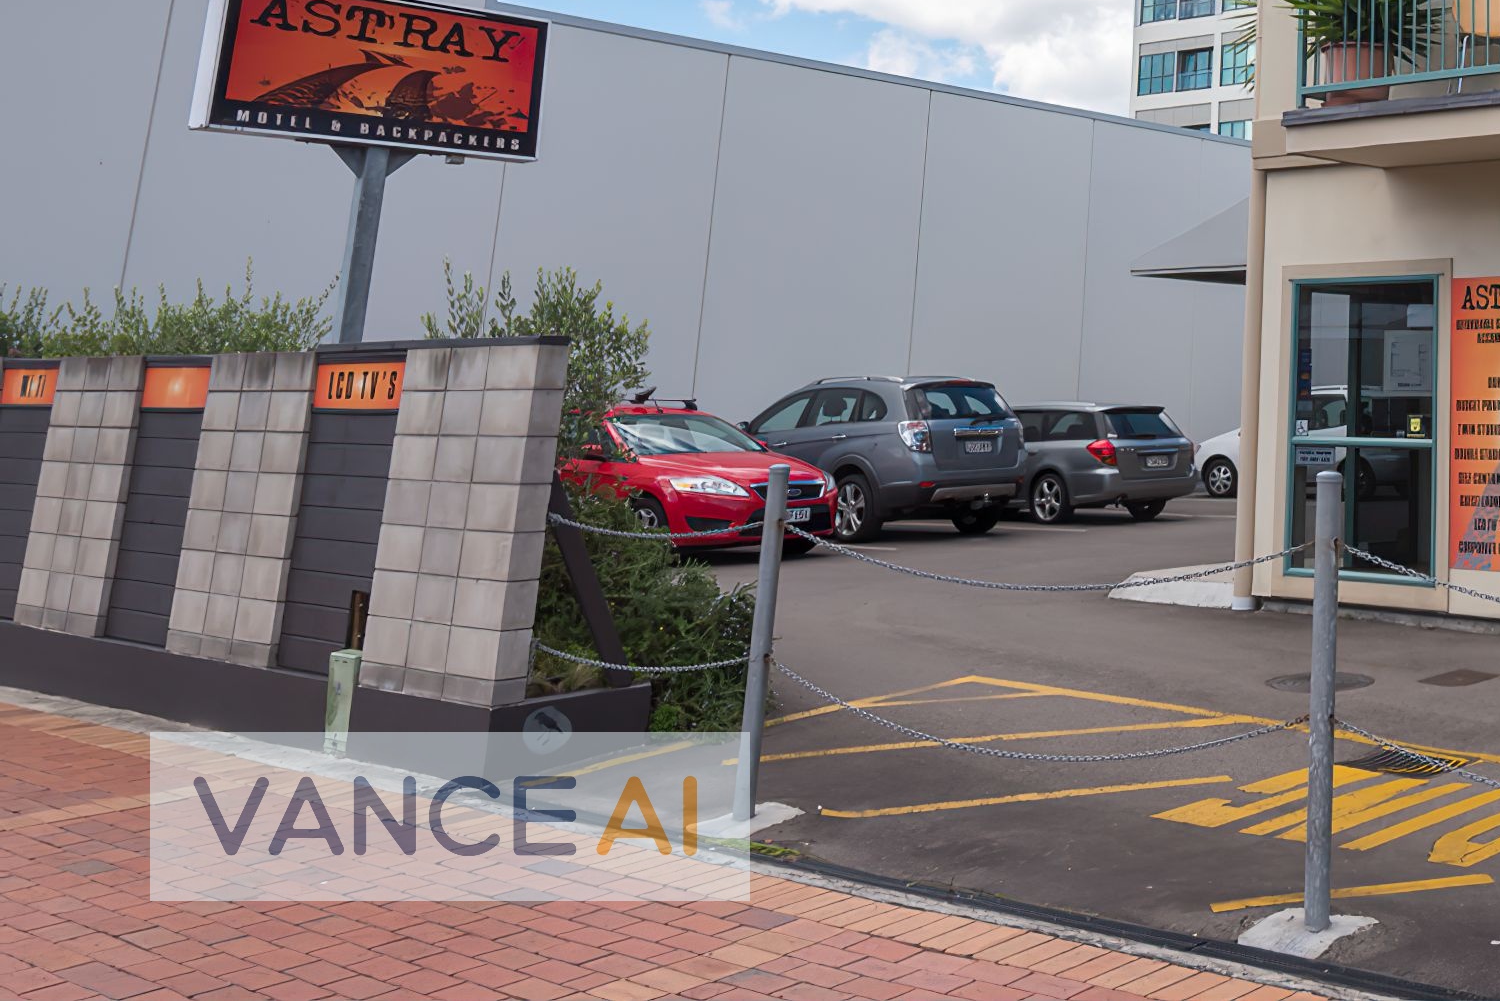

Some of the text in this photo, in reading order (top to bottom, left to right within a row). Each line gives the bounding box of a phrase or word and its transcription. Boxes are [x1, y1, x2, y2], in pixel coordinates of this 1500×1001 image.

[236, 109, 312, 129] MOTEL
[360, 122, 521, 150] BACKPACKERS
[328, 371, 398, 399] LCD TV'S
